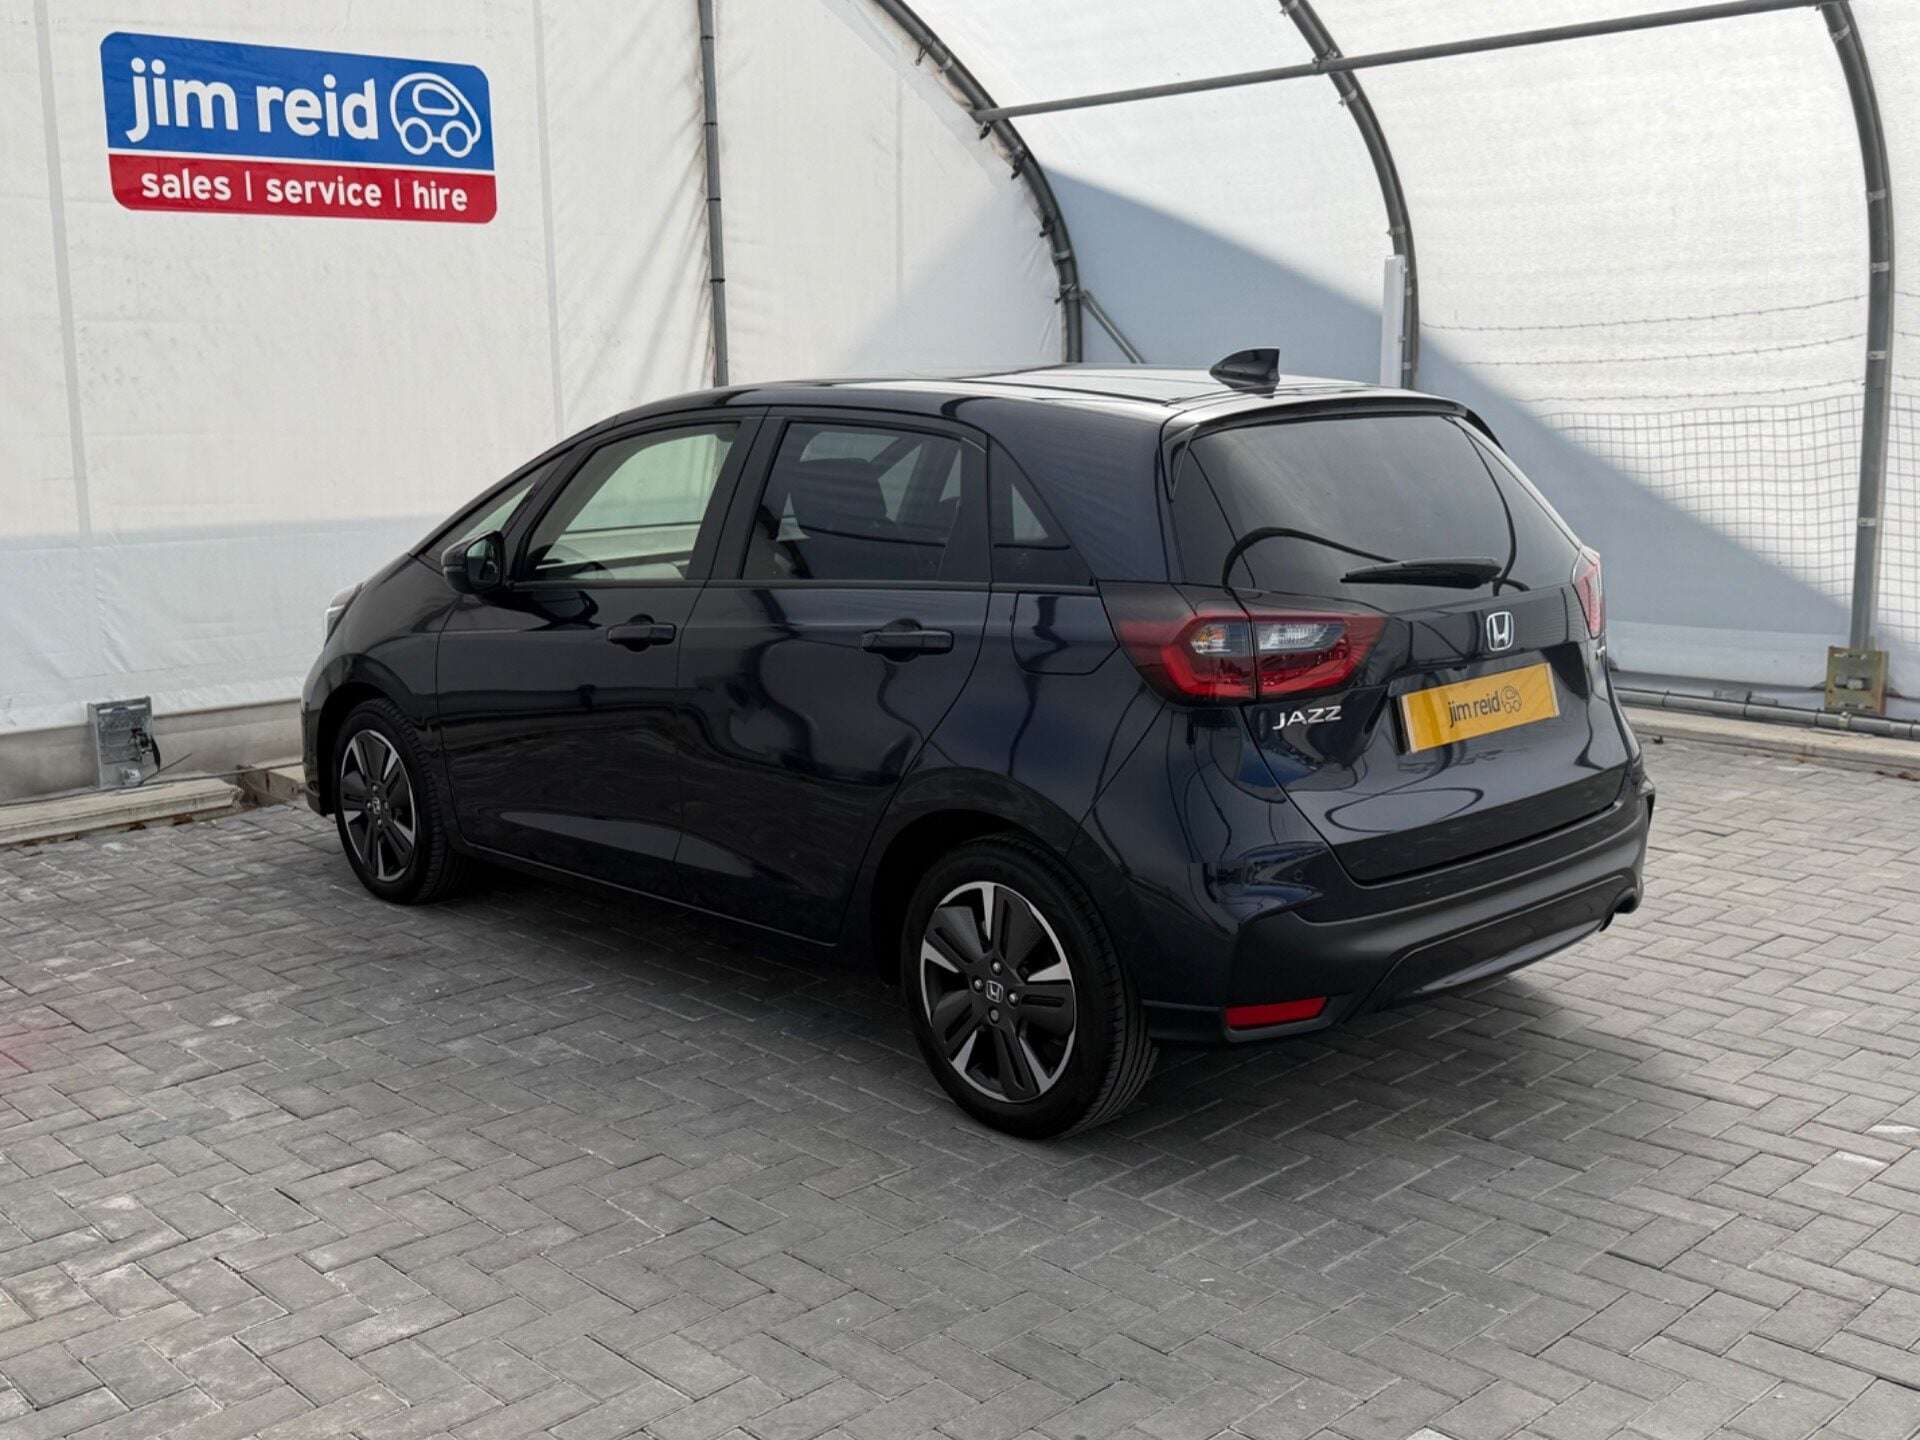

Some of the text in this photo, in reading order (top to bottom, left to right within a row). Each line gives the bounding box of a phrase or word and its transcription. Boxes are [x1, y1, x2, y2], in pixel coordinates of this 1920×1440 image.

[126, 57, 379, 143] jim reid
[141, 168, 468, 211] sales service hire
[1272, 705, 1342, 730] JAZZ
[1448, 690, 1500, 728] jim reid
